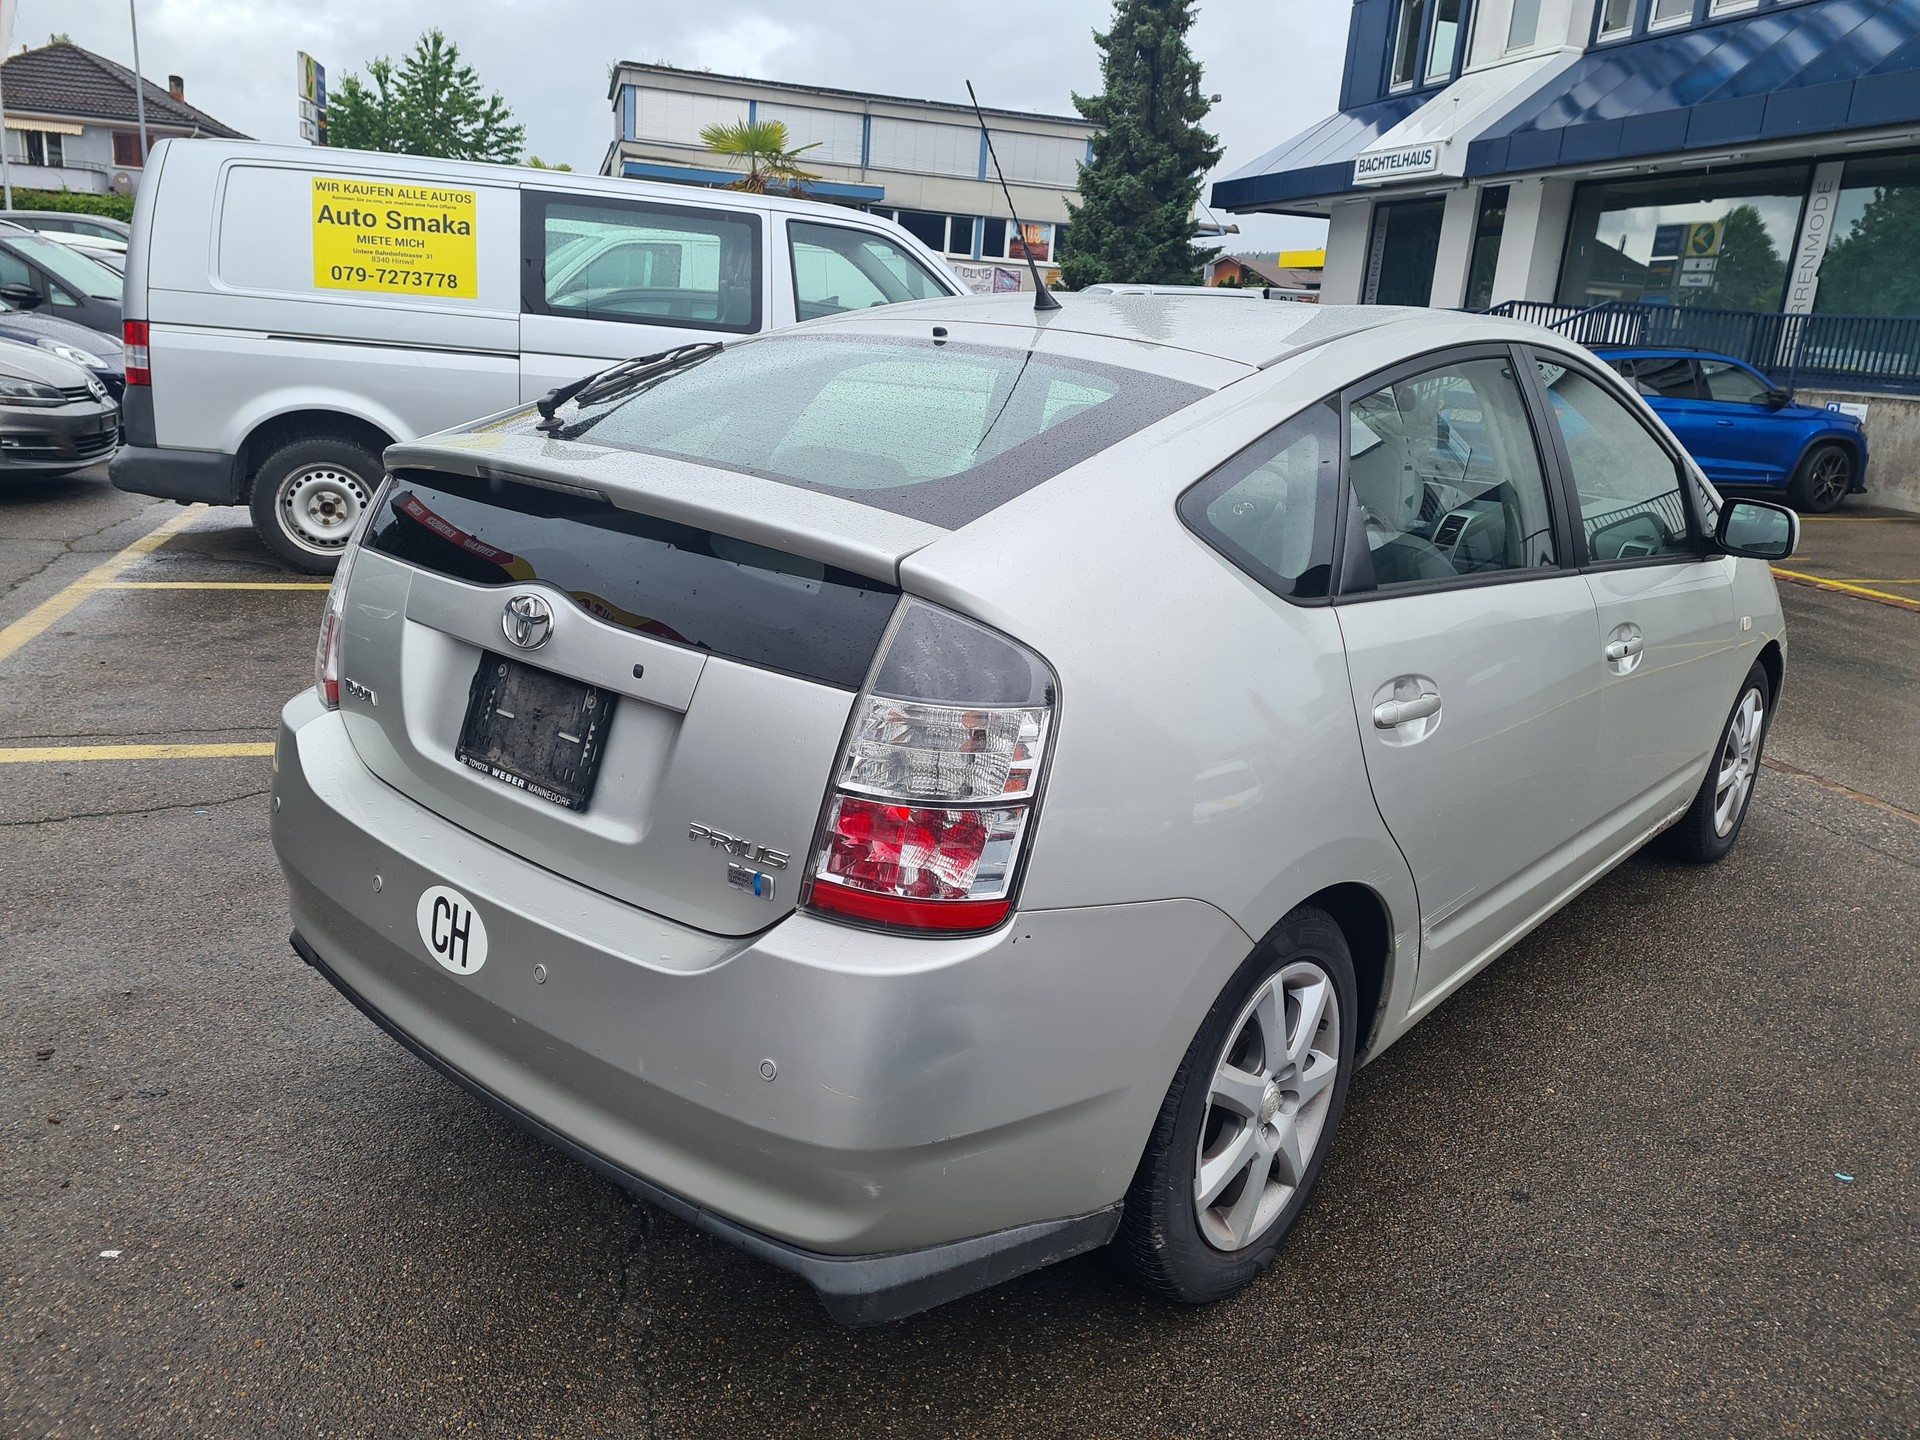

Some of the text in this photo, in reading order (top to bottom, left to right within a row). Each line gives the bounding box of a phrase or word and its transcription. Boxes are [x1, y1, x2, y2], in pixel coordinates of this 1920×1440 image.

[1358, 149, 1432, 173] BACHTELHAUS
[315, 181, 472, 204] WIR KAUFEN ALLE AUTOS
[317, 204, 471, 236] Auto Smaka
[356, 234, 425, 249] MIETE MICH
[371, 256, 415, 265] 8340 Hinwil
[374, 249, 423, 259] Bahnhofstrasse
[330, 265, 458, 289] 079-7273778
[962, 267, 992, 280] CLUB
[468, 758, 489, 773] TOYOTA
[491, 767, 525, 788] WEBER
[688, 821, 791, 870] PRIUS
[431, 895, 472, 969] CH
